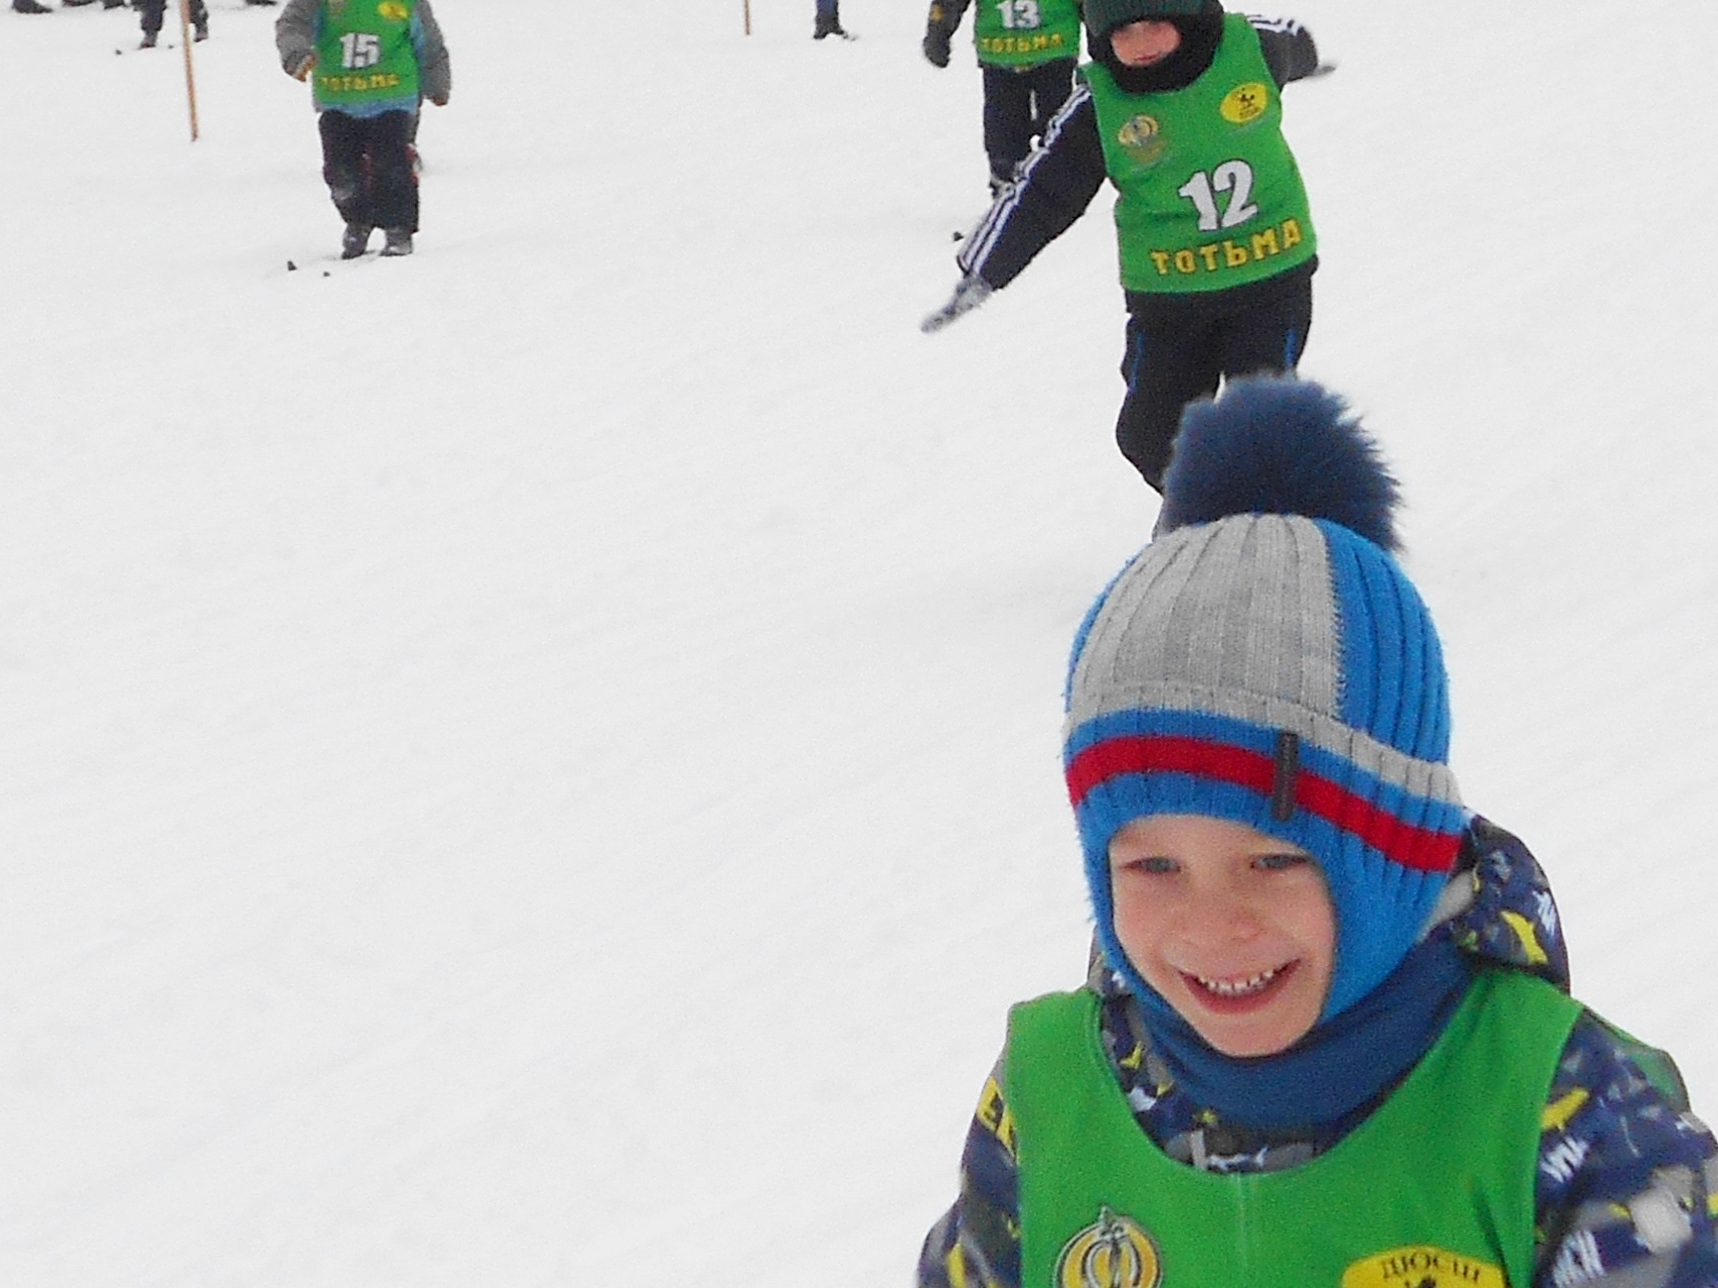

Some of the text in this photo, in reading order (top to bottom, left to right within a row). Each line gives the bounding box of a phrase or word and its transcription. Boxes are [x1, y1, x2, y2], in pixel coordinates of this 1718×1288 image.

[339, 32, 382, 68] 15
[981, 33, 1063, 53] ТОТЬМА
[1177, 157, 1260, 233] 12
[1150, 217, 1303, 276] ТОТЬМА
